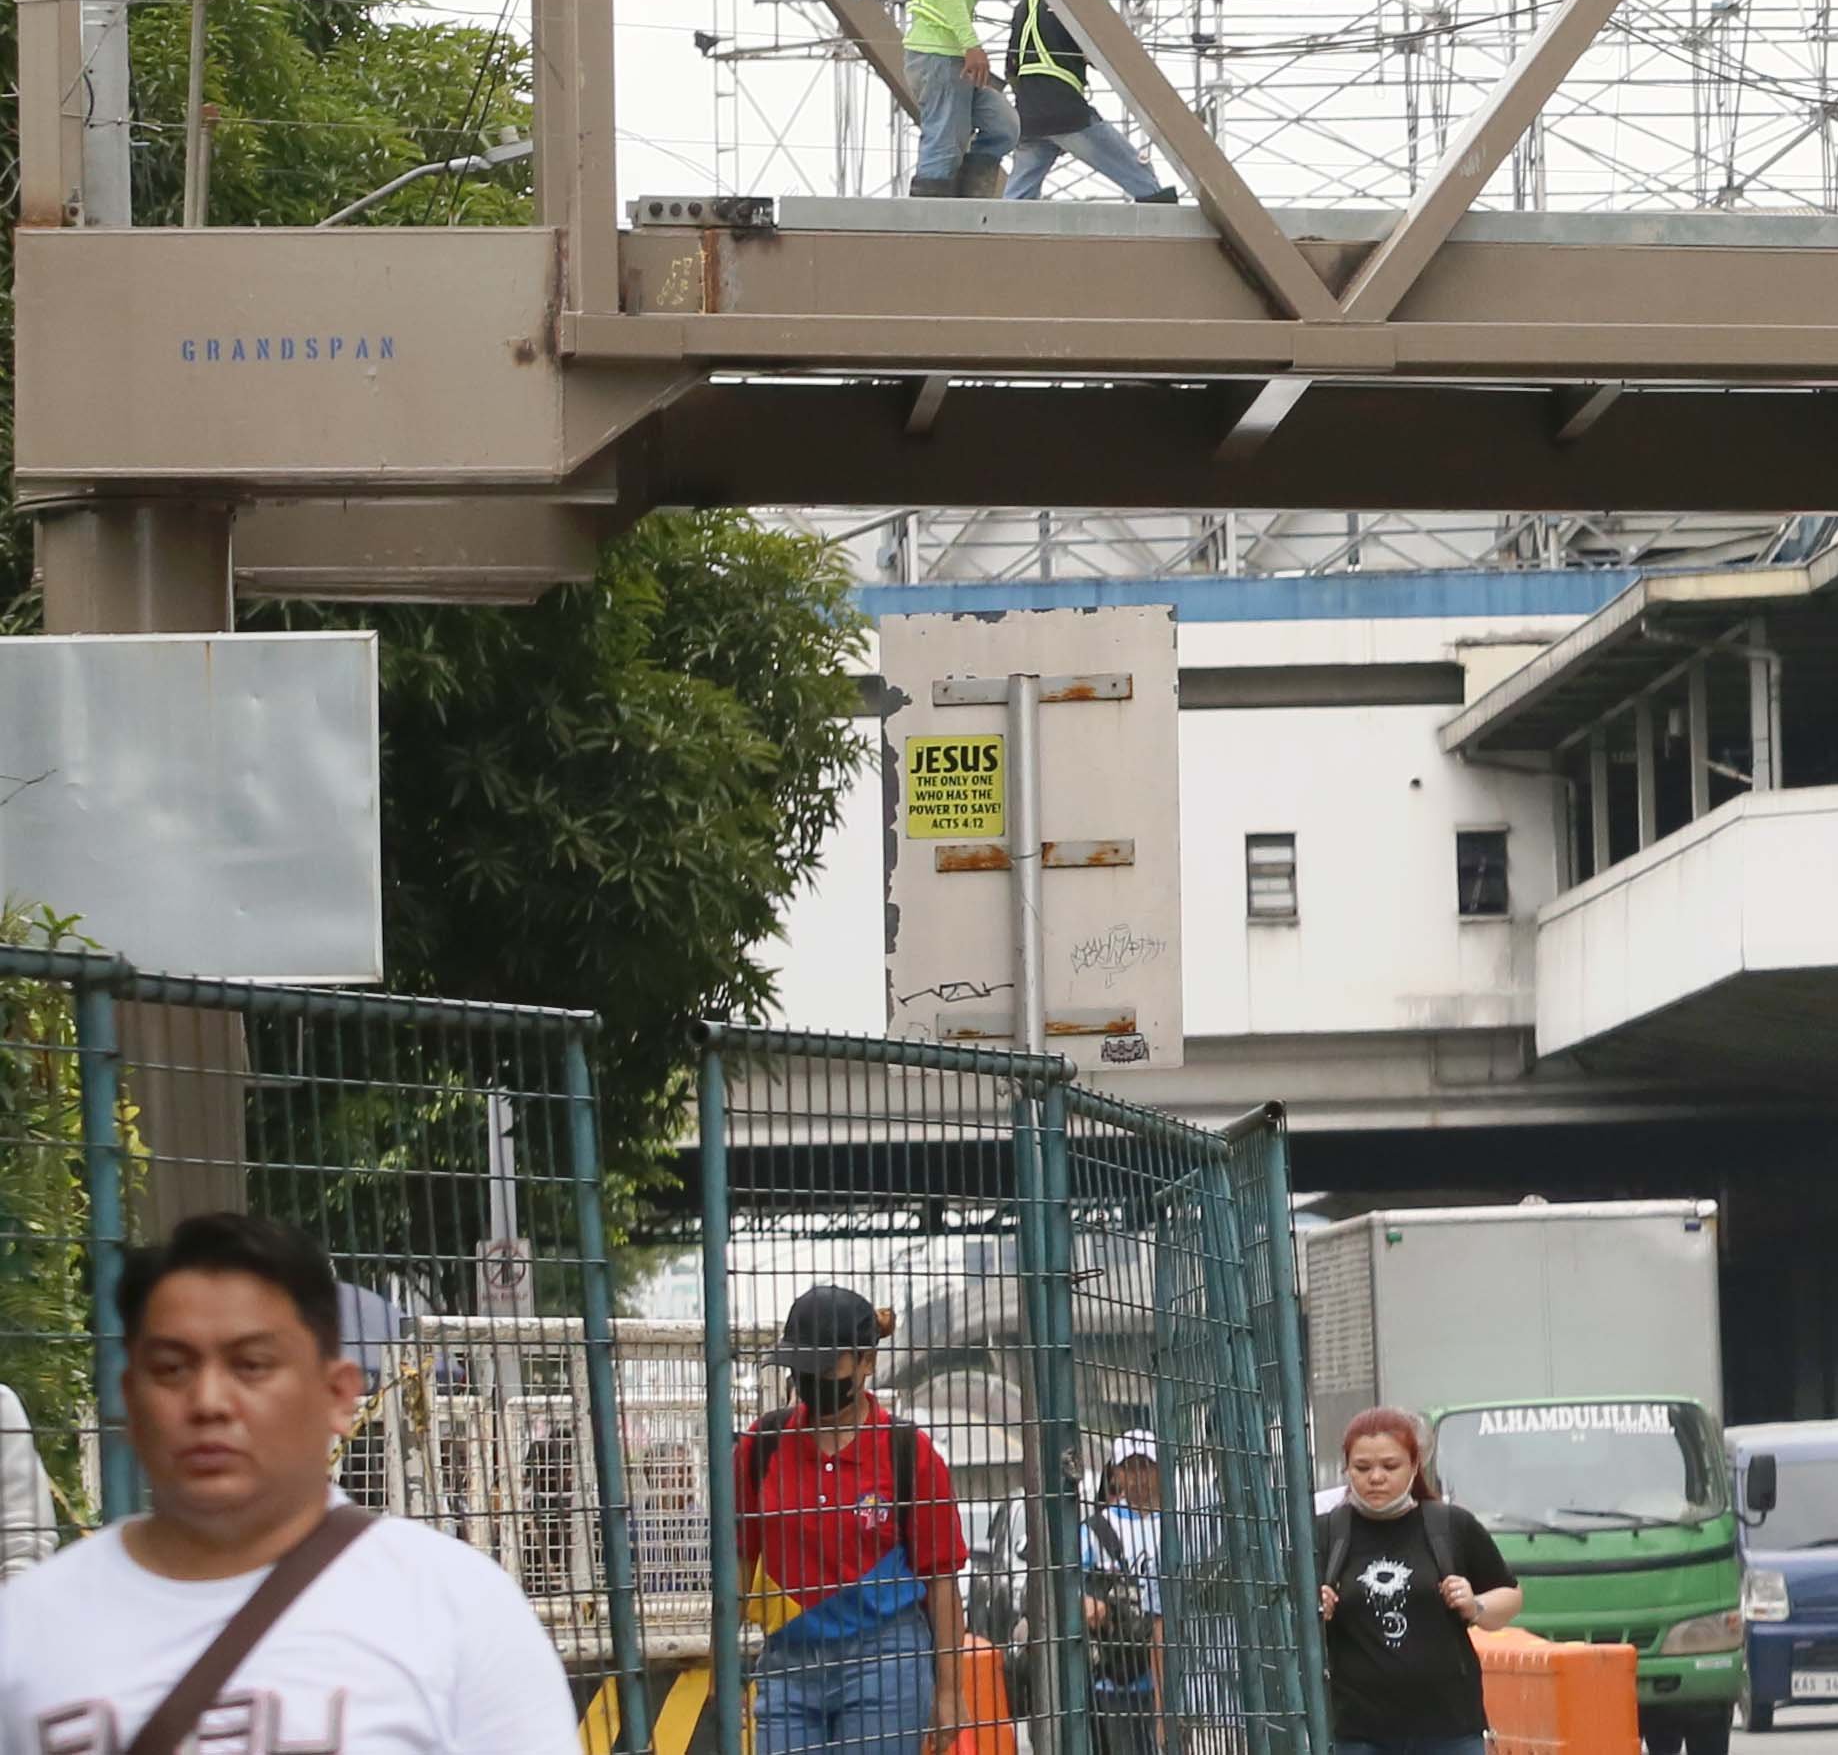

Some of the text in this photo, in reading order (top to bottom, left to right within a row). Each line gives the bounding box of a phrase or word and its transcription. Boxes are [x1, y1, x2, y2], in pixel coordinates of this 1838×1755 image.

[182, 336, 394, 362] GRANDSPAN
[910, 744, 998, 773] JESUS
[917, 775, 993, 787] THE ONLY ONE
[915, 789, 993, 801] WHO HAS THE
[908, 803, 1001, 815] POWER TO SAVE!
[931, 818, 959, 829] ACTS
[1479, 1403, 1671, 1436] ALHAMDULILLAH
